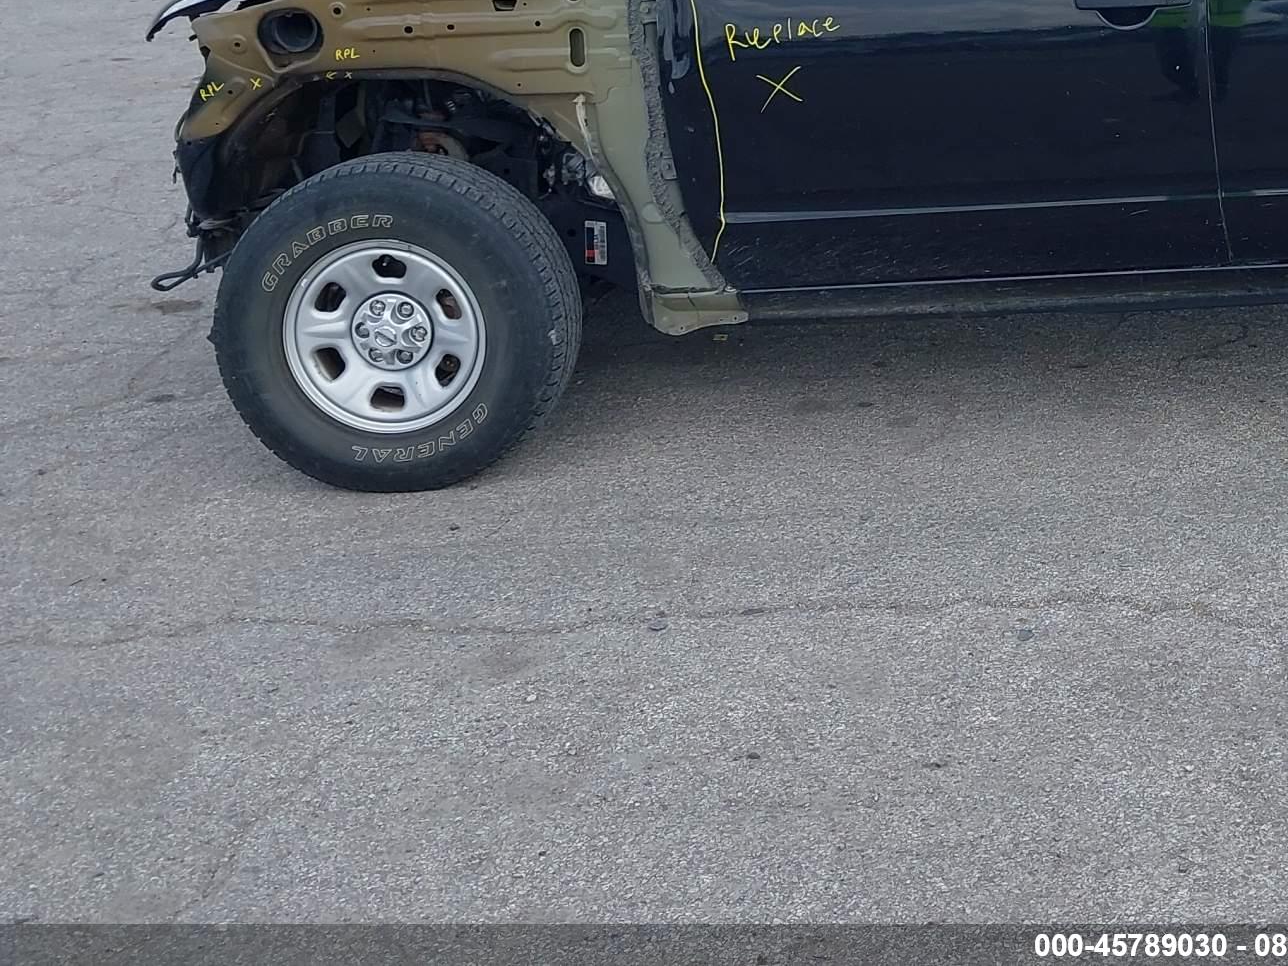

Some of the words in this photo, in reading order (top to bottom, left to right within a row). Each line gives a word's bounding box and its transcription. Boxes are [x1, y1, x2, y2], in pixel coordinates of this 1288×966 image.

[335, 48, 360, 61] RPL
[725, 17, 840, 61] Replace
[200, 81, 224, 102] RPL
[262, 215, 393, 291] GRABBER
[352, 403, 487, 463] GENERAL
